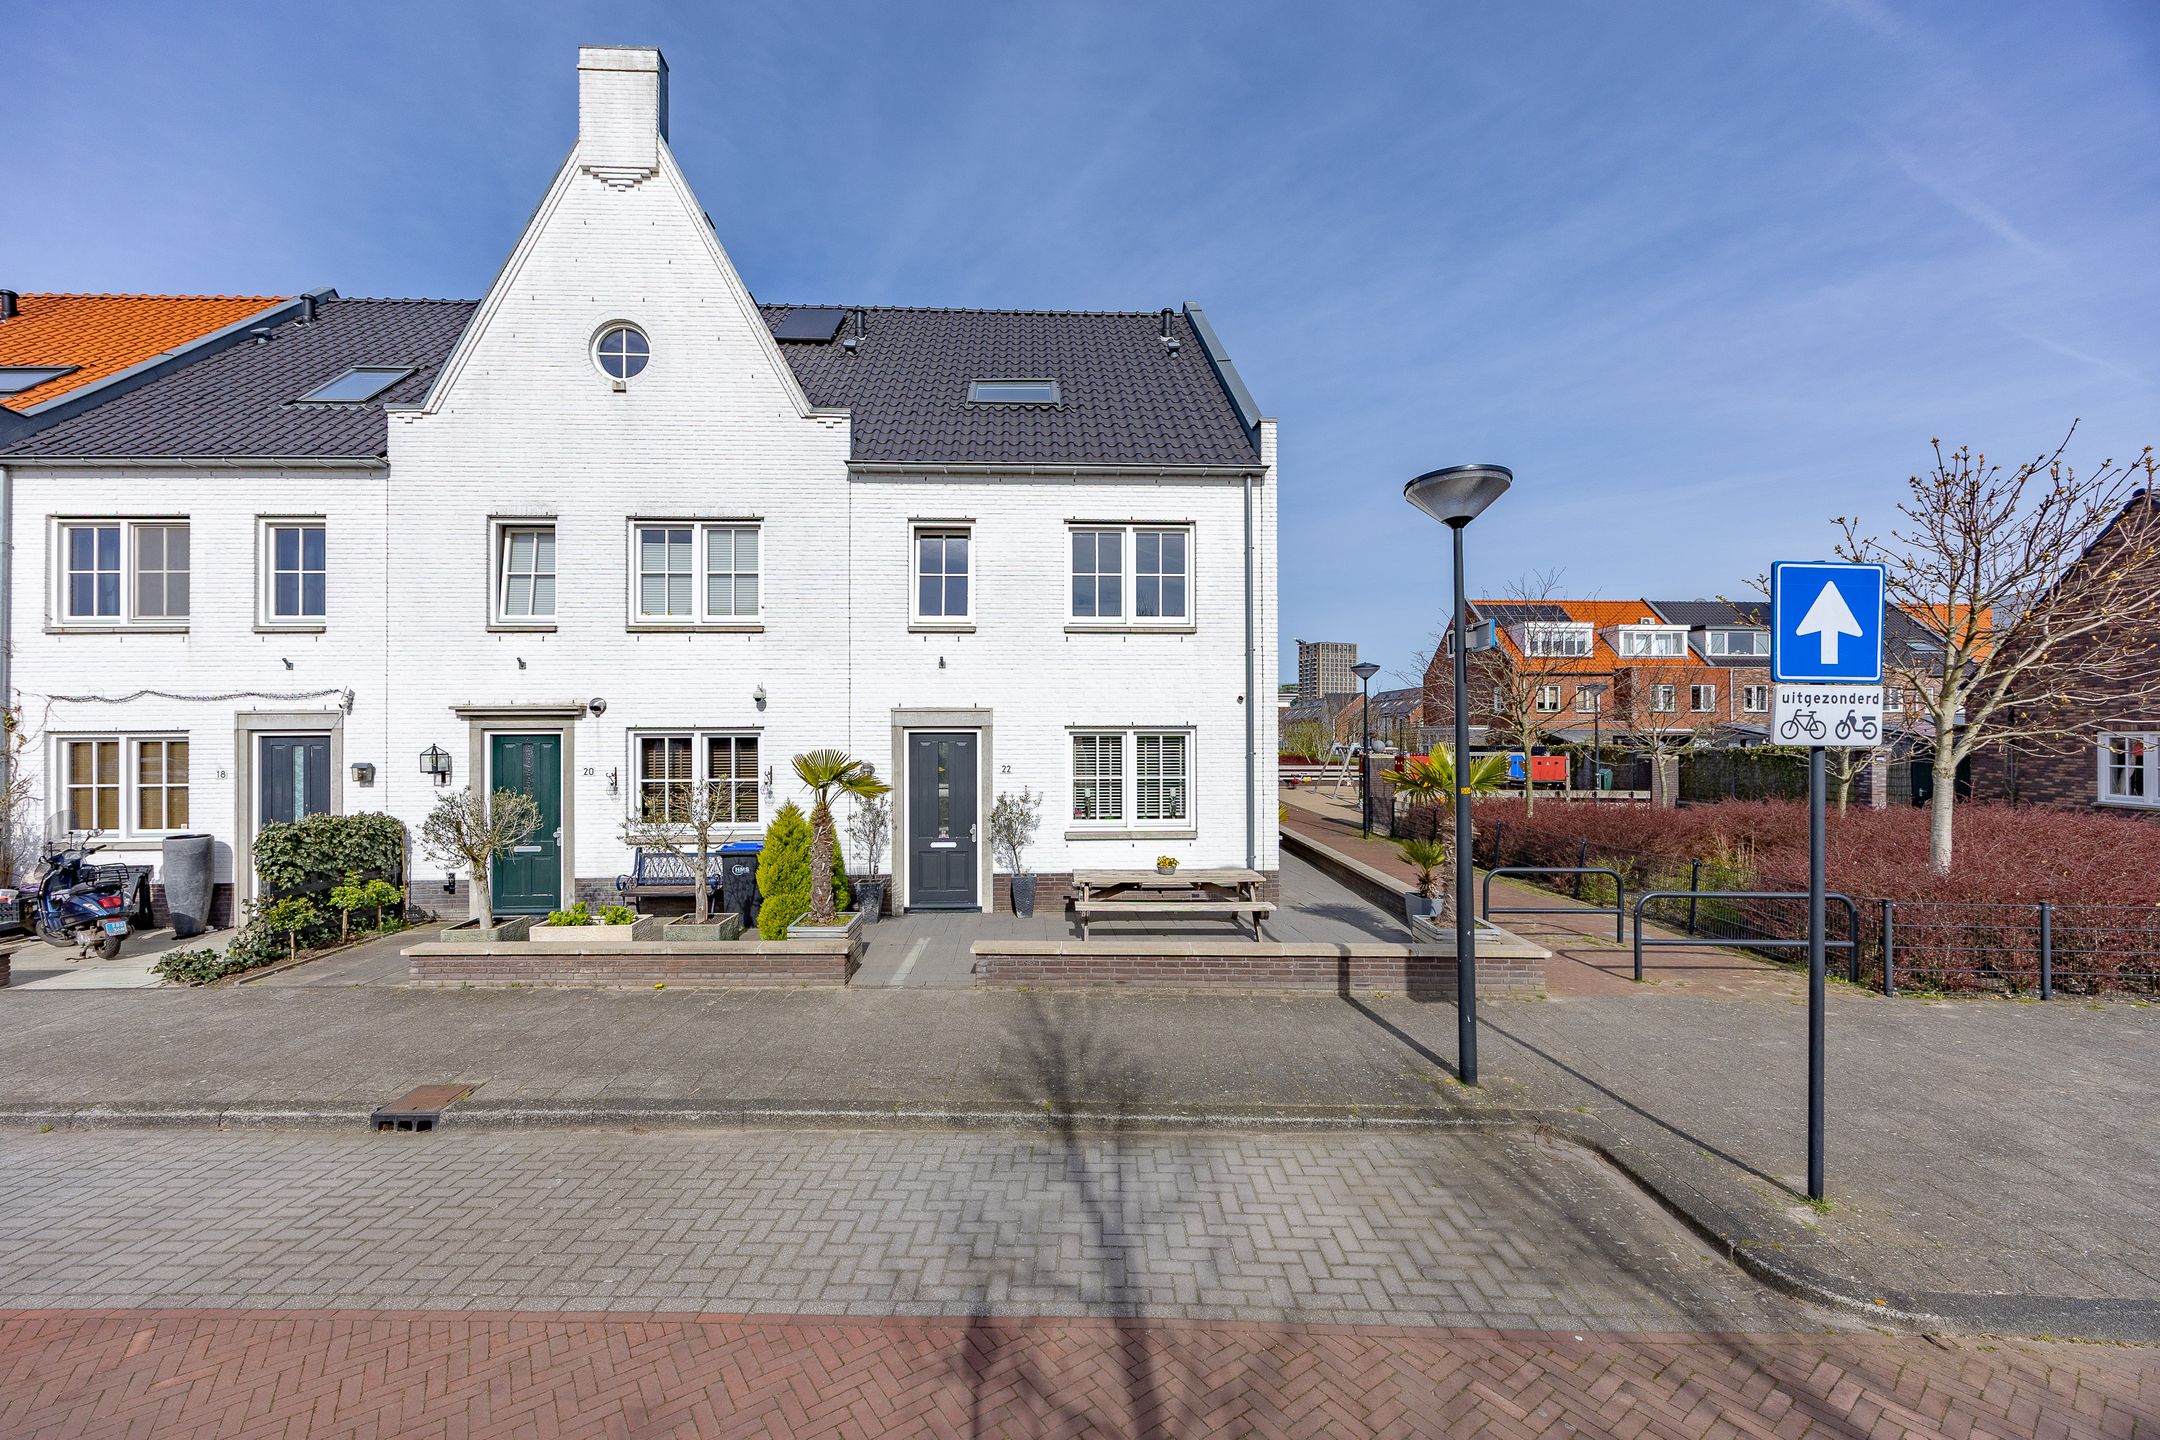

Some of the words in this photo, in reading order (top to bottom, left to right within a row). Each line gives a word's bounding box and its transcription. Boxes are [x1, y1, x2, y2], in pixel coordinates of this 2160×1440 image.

[1782, 692, 1879, 707] uitgezonderd
[583, 767, 594, 775] 20
[1001, 765, 1011, 773] 22
[216, 770, 226, 778] 18
